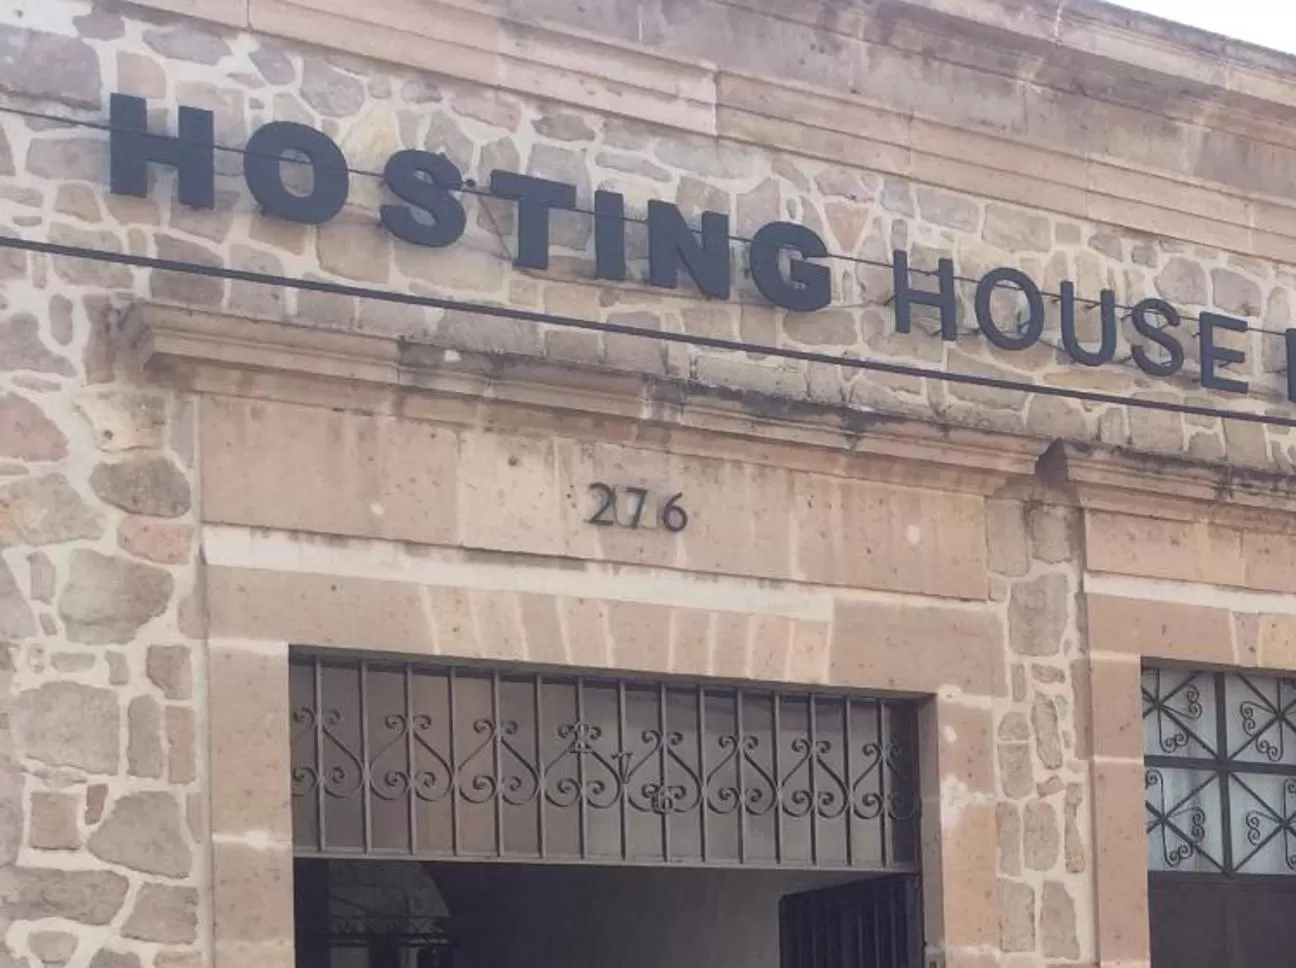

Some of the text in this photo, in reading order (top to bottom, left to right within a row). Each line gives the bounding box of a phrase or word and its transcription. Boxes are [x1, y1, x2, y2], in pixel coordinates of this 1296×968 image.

[109, 92, 832, 312] HOSTING
[893, 249, 1249, 394] HOUSE
[587, 482, 688, 532] 276
